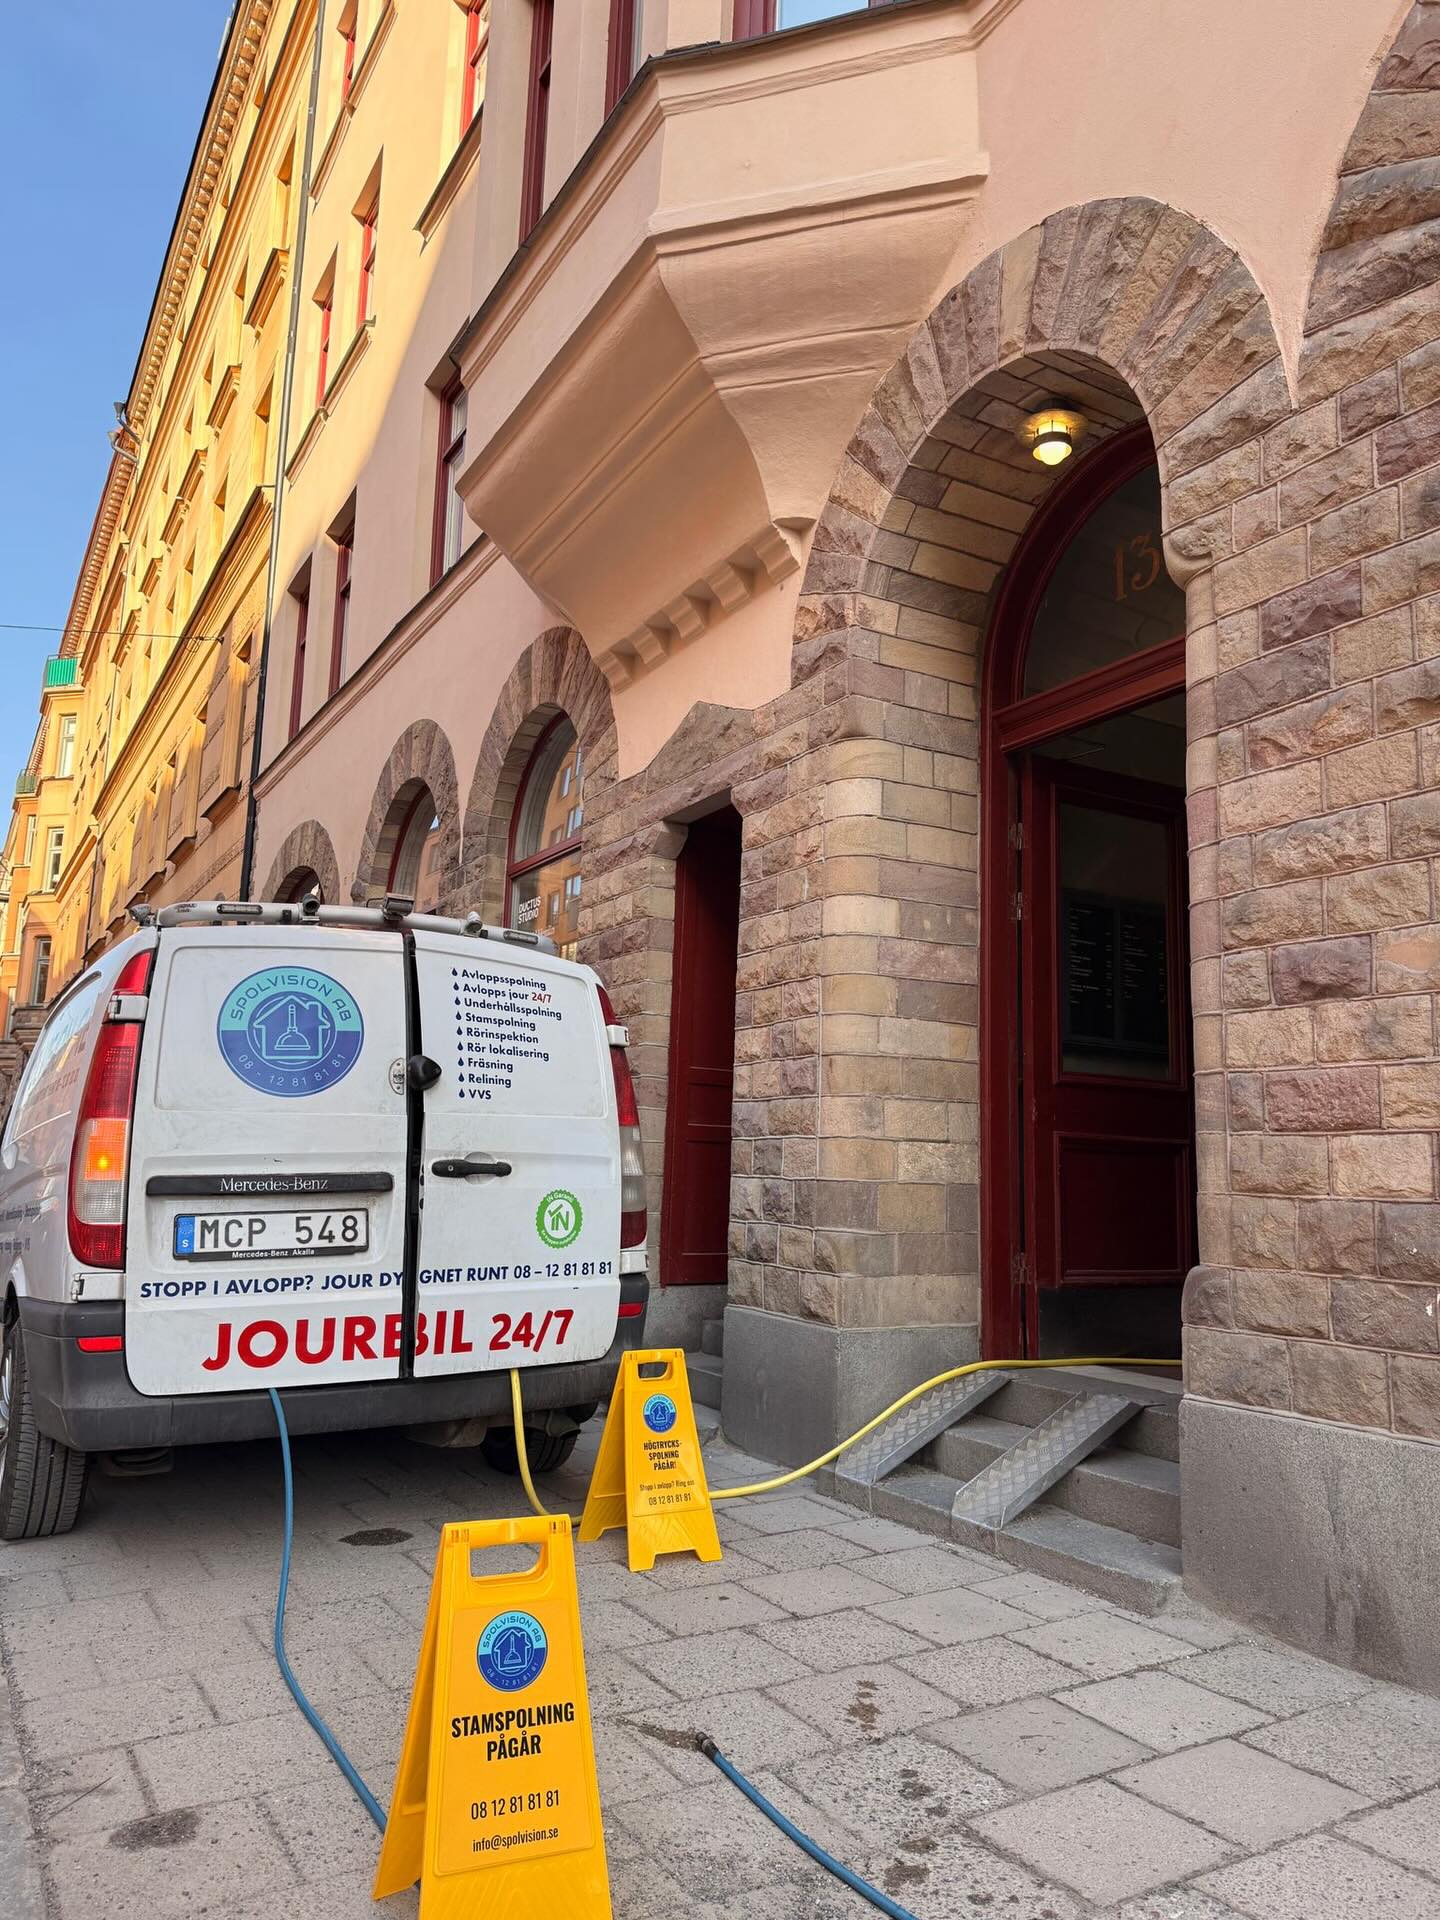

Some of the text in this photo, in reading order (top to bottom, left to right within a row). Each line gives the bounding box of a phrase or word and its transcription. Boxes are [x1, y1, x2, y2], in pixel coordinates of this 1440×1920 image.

[519, 896, 541, 914] DUCTUS
[518, 907, 539, 924] STUDIO
[461, 969, 547, 991] Avloppsspolning
[231, 975, 352, 1022] SPOLVISION AB
[463, 983, 552, 1004] Avlopps jour 24/7
[464, 997, 562, 1020] Underhållsspolning
[465, 1012, 536, 1031] Stamspolning
[466, 1027, 539, 1044] Rörinspektion
[467, 1042, 549, 1061] Rör lokalisering
[238, 1054, 254, 1070] 08
[269, 1075, 285, 1086] 12
[291, 1077, 307, 1087] 81
[314, 1068, 330, 1081] 81
[331, 1053, 346, 1068] 81
[468, 1057, 514, 1073] Fräsning
[468, 1073, 512, 1088] Relining
[468, 1089, 492, 1100] VVS
[220, 1178, 328, 1192] Mercedes-Benz
[200, 1215, 359, 1249] MCP 548
[182, 1239, 189, 1248] S
[231, 1250, 289, 1259] Mercedes-Benz
[140, 1280, 207, 1298] STOPP
[213, 1280, 219, 1295] I
[225, 1275, 315, 1295] AVLOPP?
[321, 1273, 373, 1290] JOUR
[467, 1266, 509, 1282] RUNT
[514, 1265, 531, 1279] 08
[545, 1264, 559, 1277] 12
[563, 1263, 578, 1276] 81
[581, 1262, 595, 1275] 81
[599, 1261, 612, 1274] 81
[489, 1309, 575, 1353] 24/7
[643, 1440, 682, 1450] HÖGTRYCKS-
[648, 1450, 680, 1461] SPOLNING
[648, 1492, 691, 1506] 08 12 81 81 81
[482, 1615, 542, 1649] SPOLVISION AB
[451, 1702, 575, 1738] STAMSPOLNING
[487, 1730, 542, 1761] PÅGÅR
[471, 1789, 559, 1820] 08 12 81 81 81
[472, 1827, 559, 1852] info@spolvision.se
